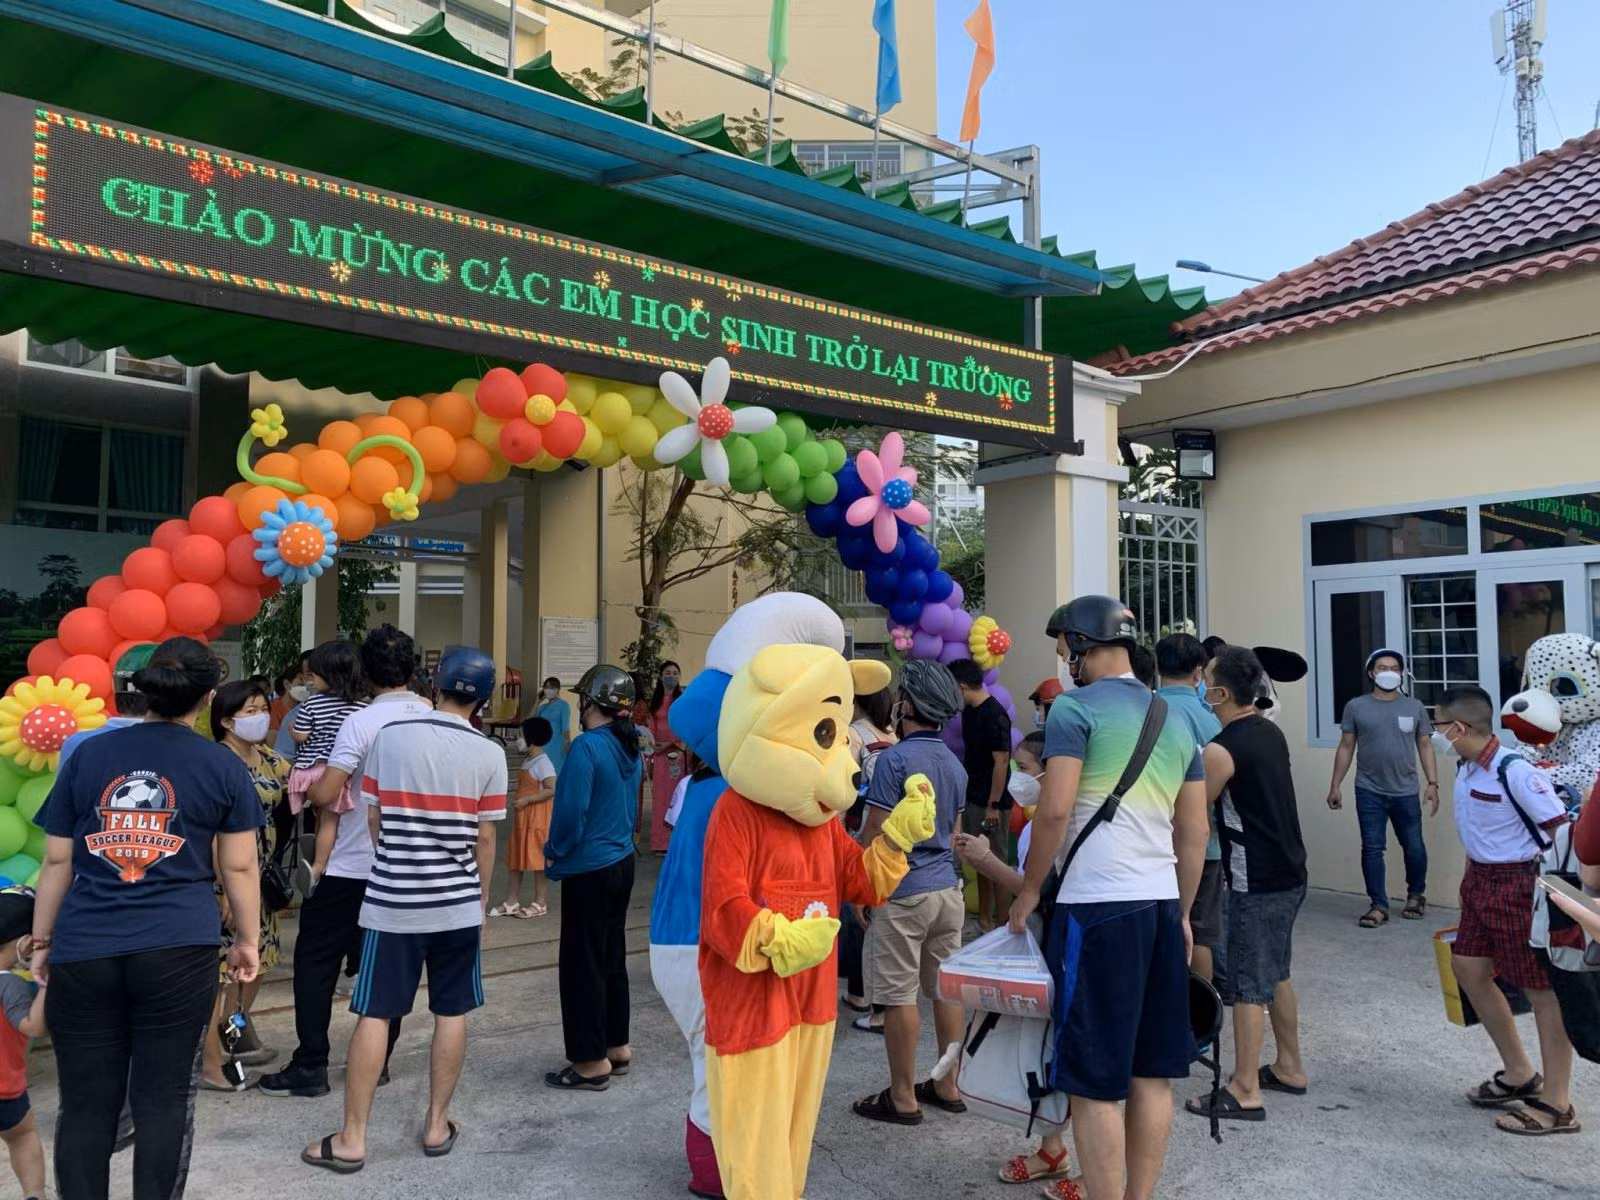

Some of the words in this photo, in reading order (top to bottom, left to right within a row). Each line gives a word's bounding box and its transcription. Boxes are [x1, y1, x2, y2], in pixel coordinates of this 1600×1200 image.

[100, 176, 276, 248] CHÀO
[289, 217, 447, 285] MỪNG
[460, 257, 551, 304] CÁC
[560, 279, 622, 321] EM
[632, 294, 711, 342] HỌC
[720, 315, 797, 358] SINH
[805, 333, 868, 371] TRỞ
[872, 349, 919, 385] LẠI
[110, 813, 161, 830] FALL
[92, 834, 131, 847] SOCCER
[135, 834, 177, 848] LEAGUE
[115, 848, 149, 859] 2019
